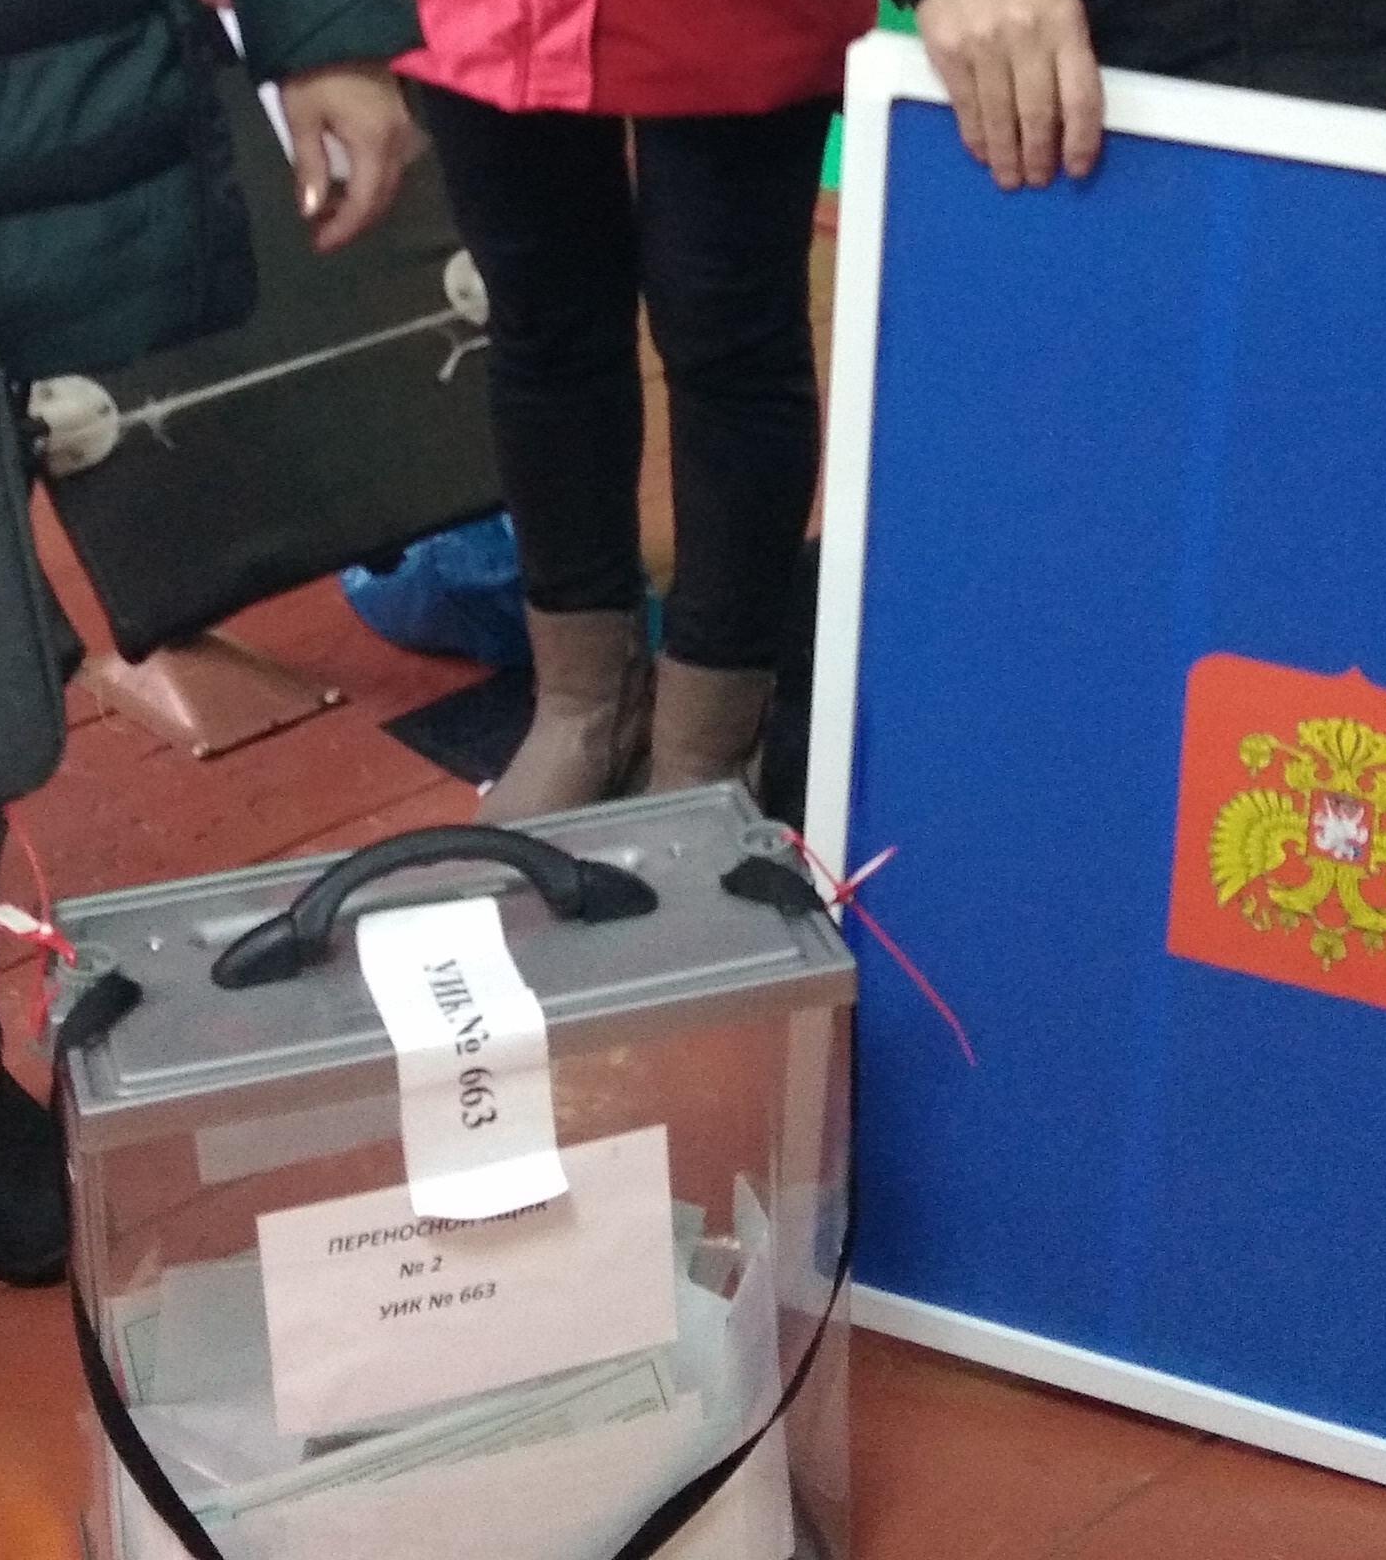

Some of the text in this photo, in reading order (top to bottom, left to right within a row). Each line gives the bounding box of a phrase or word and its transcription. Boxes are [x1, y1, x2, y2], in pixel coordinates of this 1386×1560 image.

[459, 1066, 498, 1130] 663
[399, 1254, 443, 1279] № 2
[379, 1282, 496, 1320] УИК № 663
